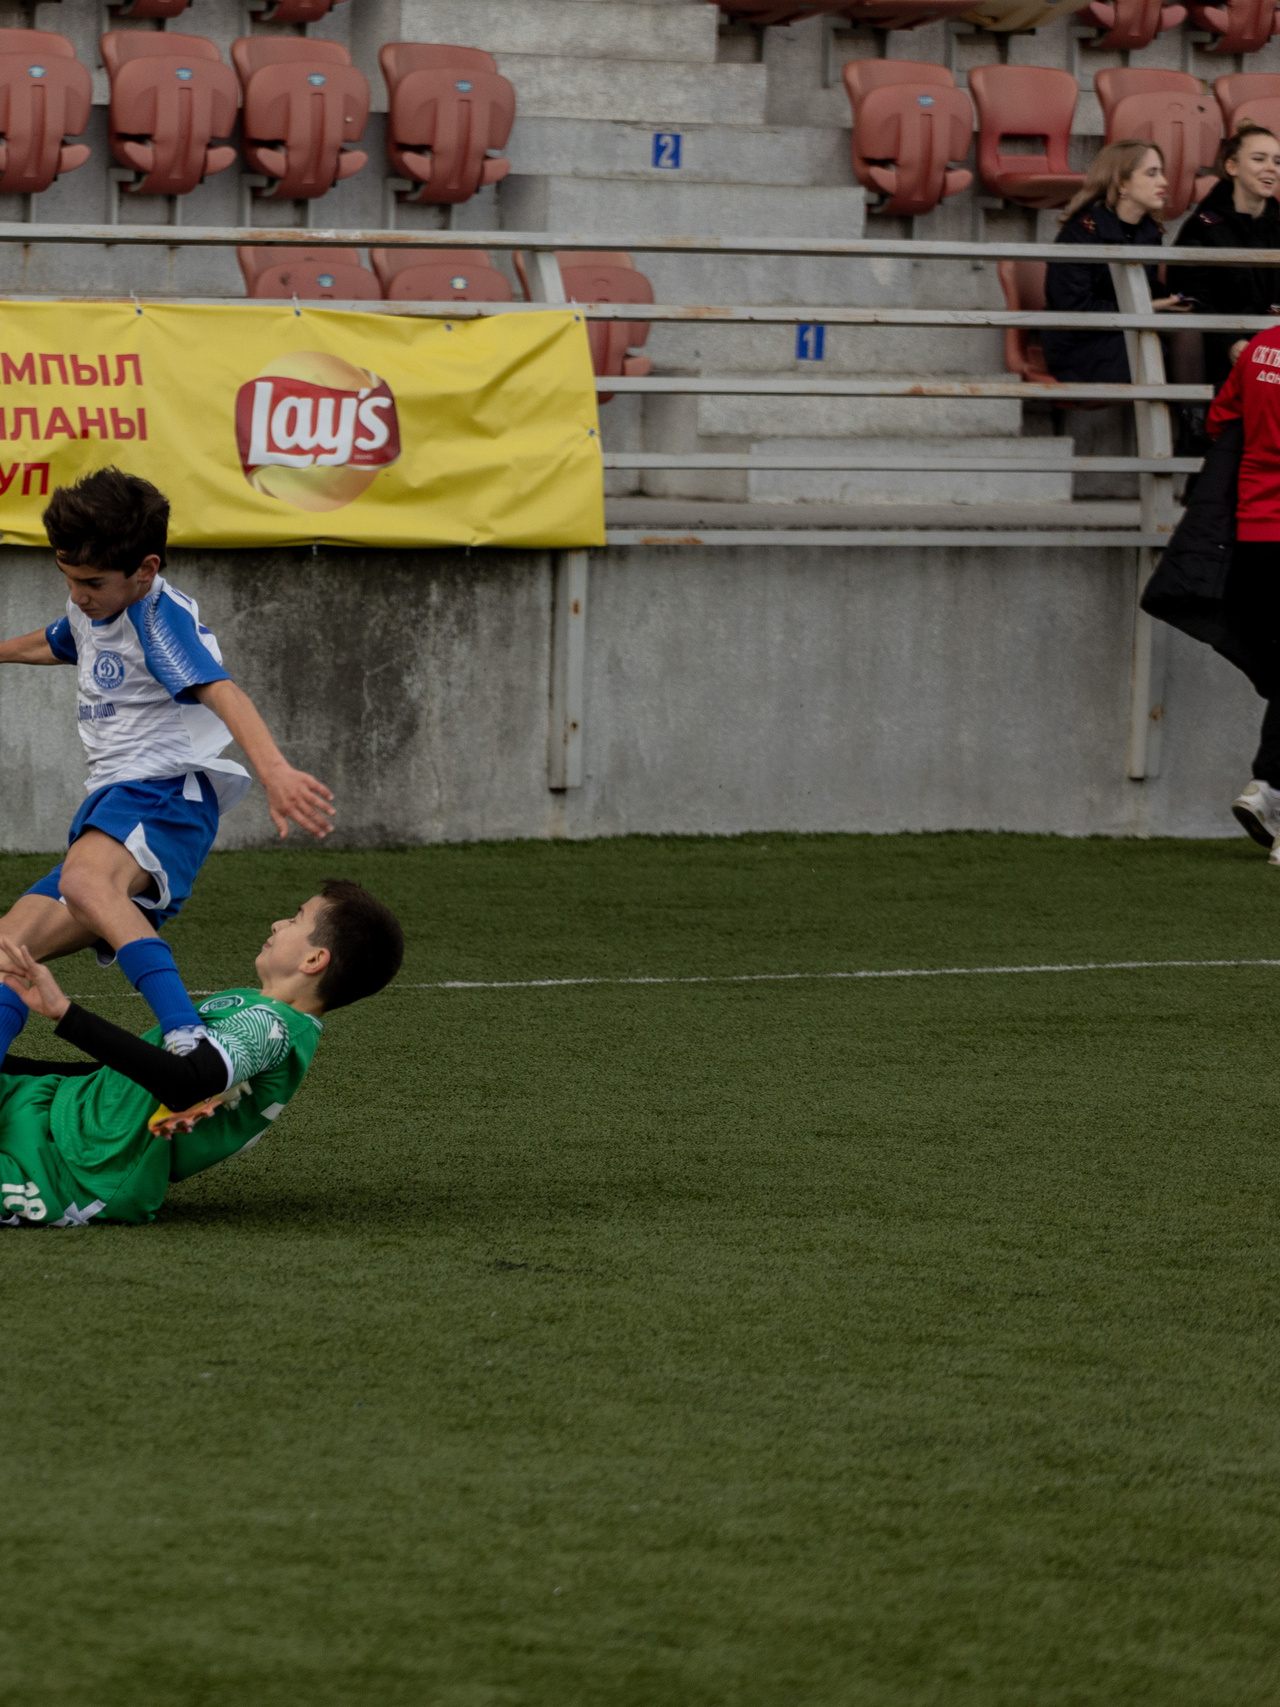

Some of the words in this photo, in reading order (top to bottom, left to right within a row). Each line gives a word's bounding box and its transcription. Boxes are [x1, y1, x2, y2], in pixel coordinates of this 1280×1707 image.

[657, 134, 675, 168] 2
[802, 324, 817, 360] 1
[248, 381, 393, 468] Lay's
[1, 1181, 47, 1220] 18
